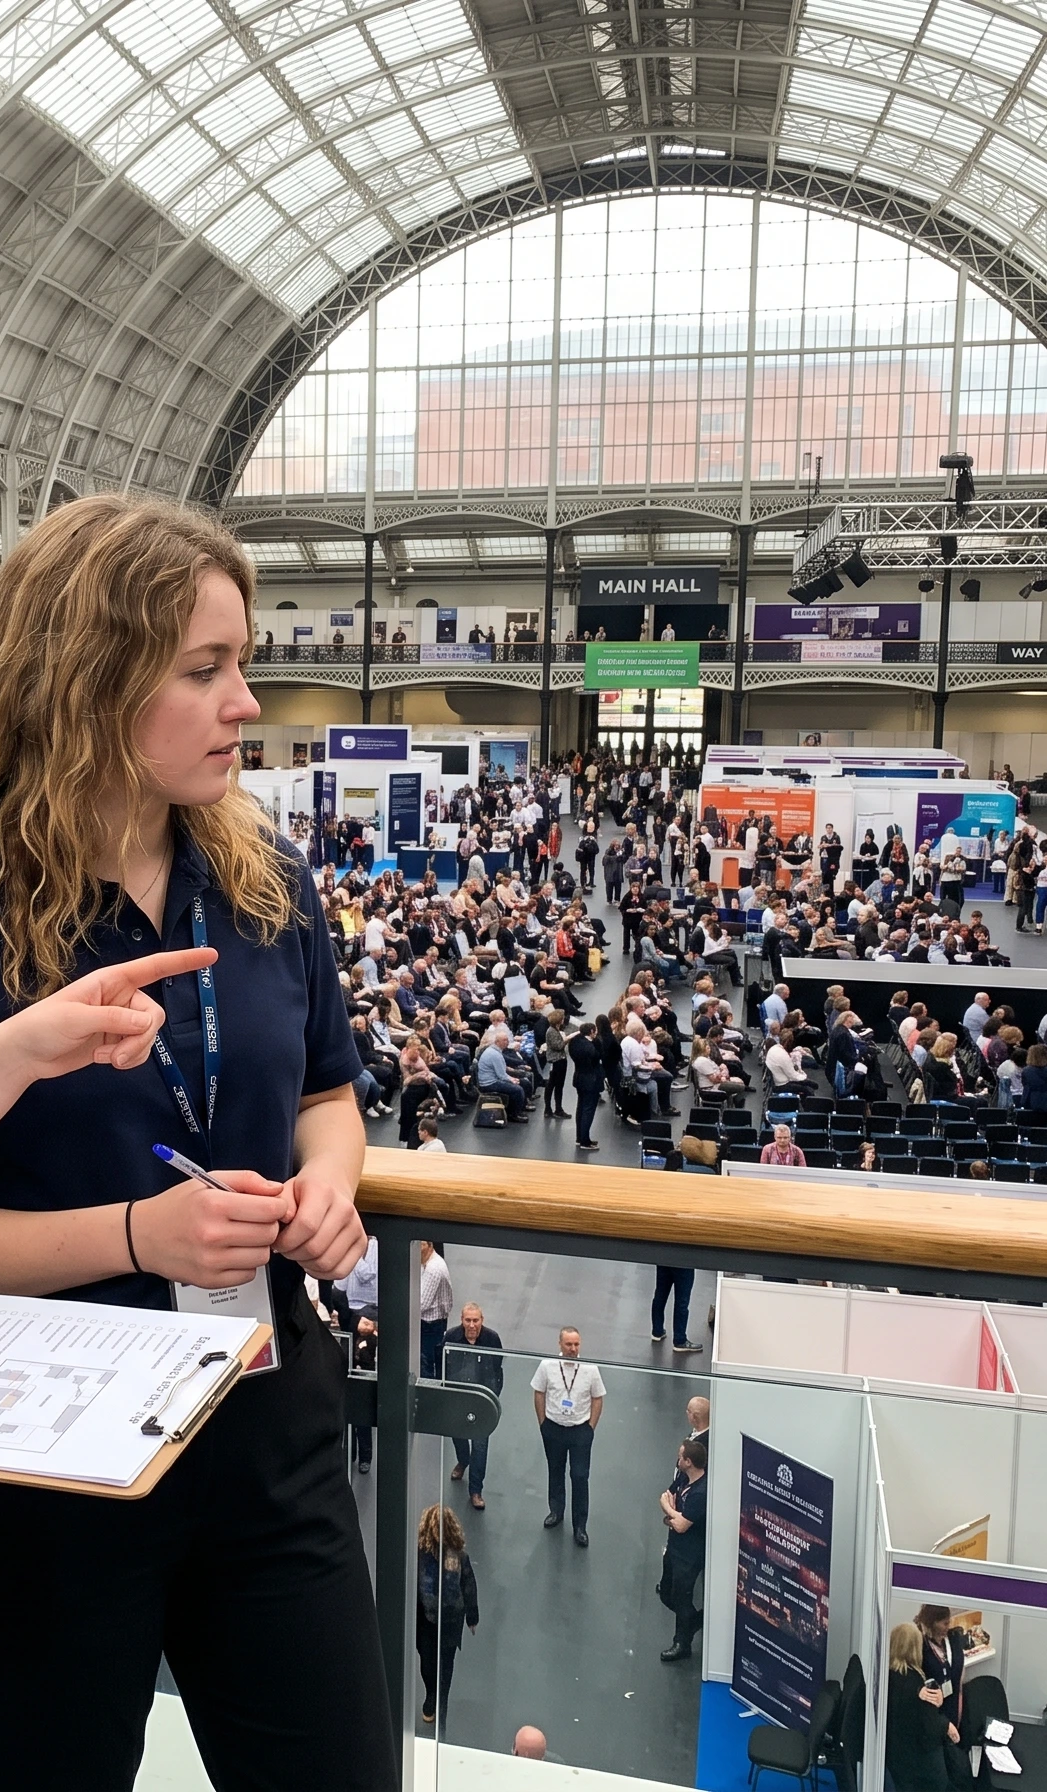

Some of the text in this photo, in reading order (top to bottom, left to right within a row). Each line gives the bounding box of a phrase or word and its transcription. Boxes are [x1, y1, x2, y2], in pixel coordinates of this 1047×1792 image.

[598, 578, 701, 594] MAIN HALL
[1011, 647, 1044, 658] WAY
